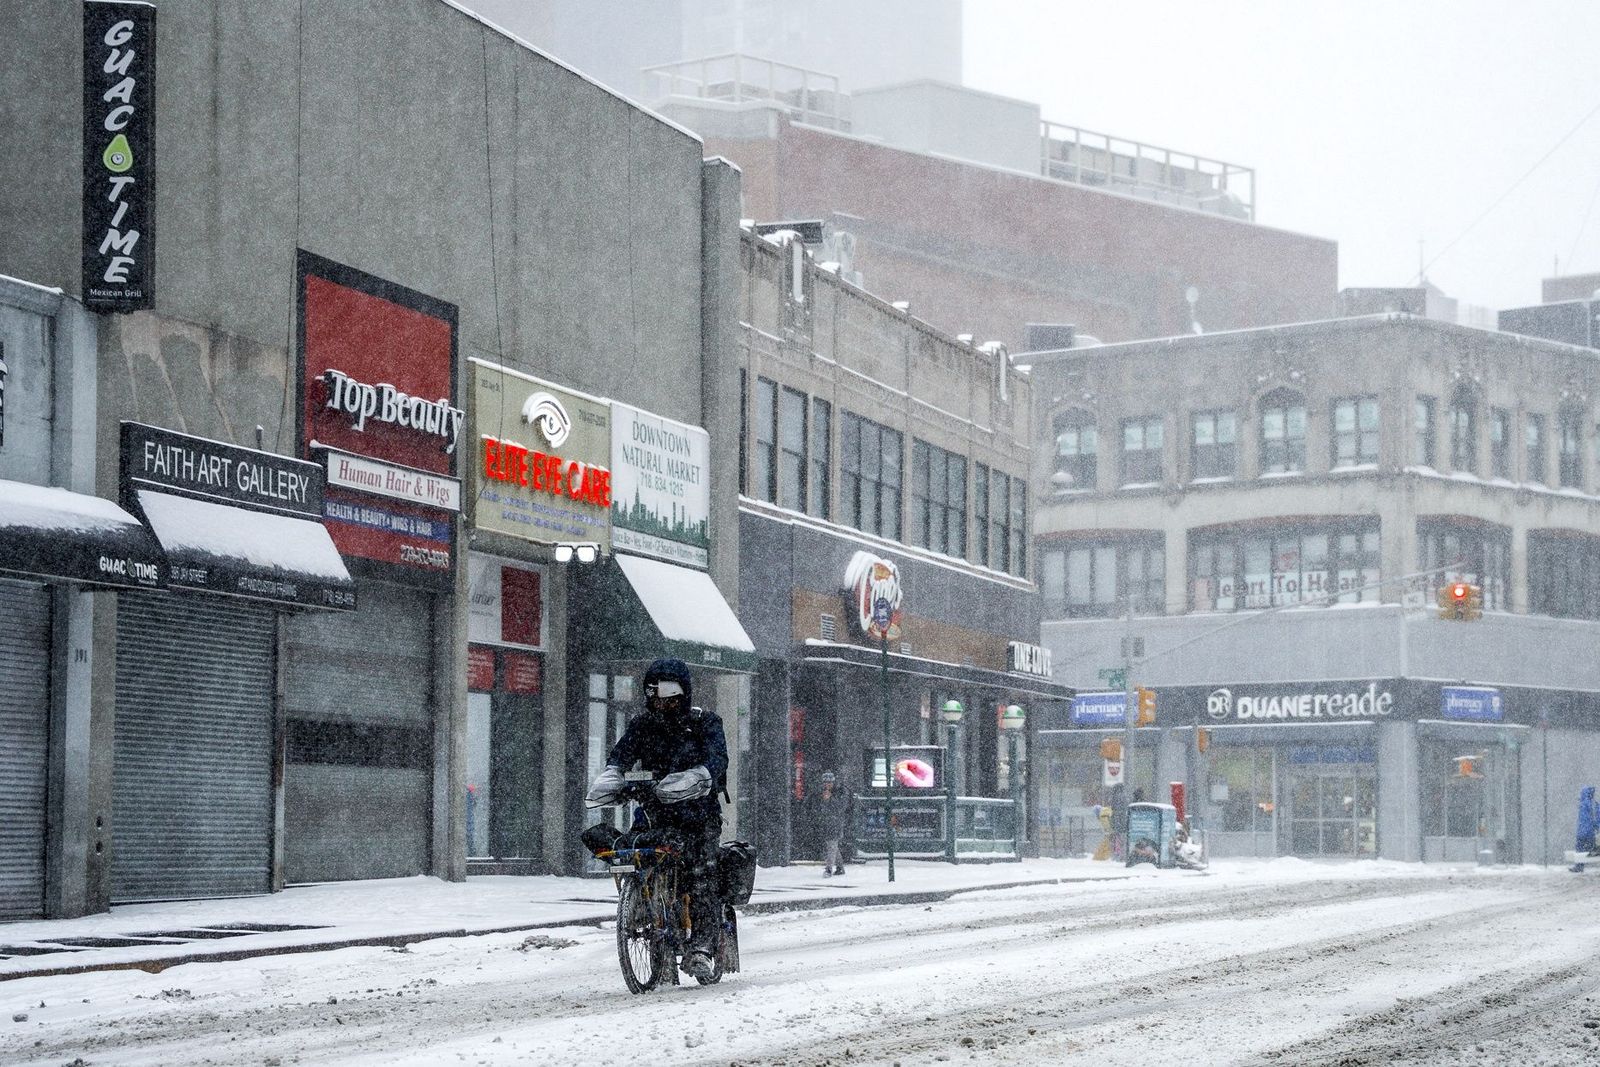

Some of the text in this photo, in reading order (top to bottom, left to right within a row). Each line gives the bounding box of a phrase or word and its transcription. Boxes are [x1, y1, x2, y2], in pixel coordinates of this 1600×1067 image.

[90, 288, 142, 298] Mexican Grill
[377, 383, 465, 454] Beauty
[632, 421, 691, 455] DOWNTOWN
[144, 441, 310, 503] FAITH ART GALLERY
[339, 459, 450, 506] Human Hair & Wigs
[484, 436, 611, 508] ELITE EYE CARE
[622, 444, 701, 486] NATURAL MARKET
[326, 502, 353, 520] HEALTH
[354, 506, 360, 520] &
[361, 509, 386, 526] BEAUTY
[391, 515, 409, 531] WIGS
[416, 521, 433, 536] HAIR
[99, 556, 158, 580] GUAC TIME
[1075, 701, 1126, 718] pharmacy
